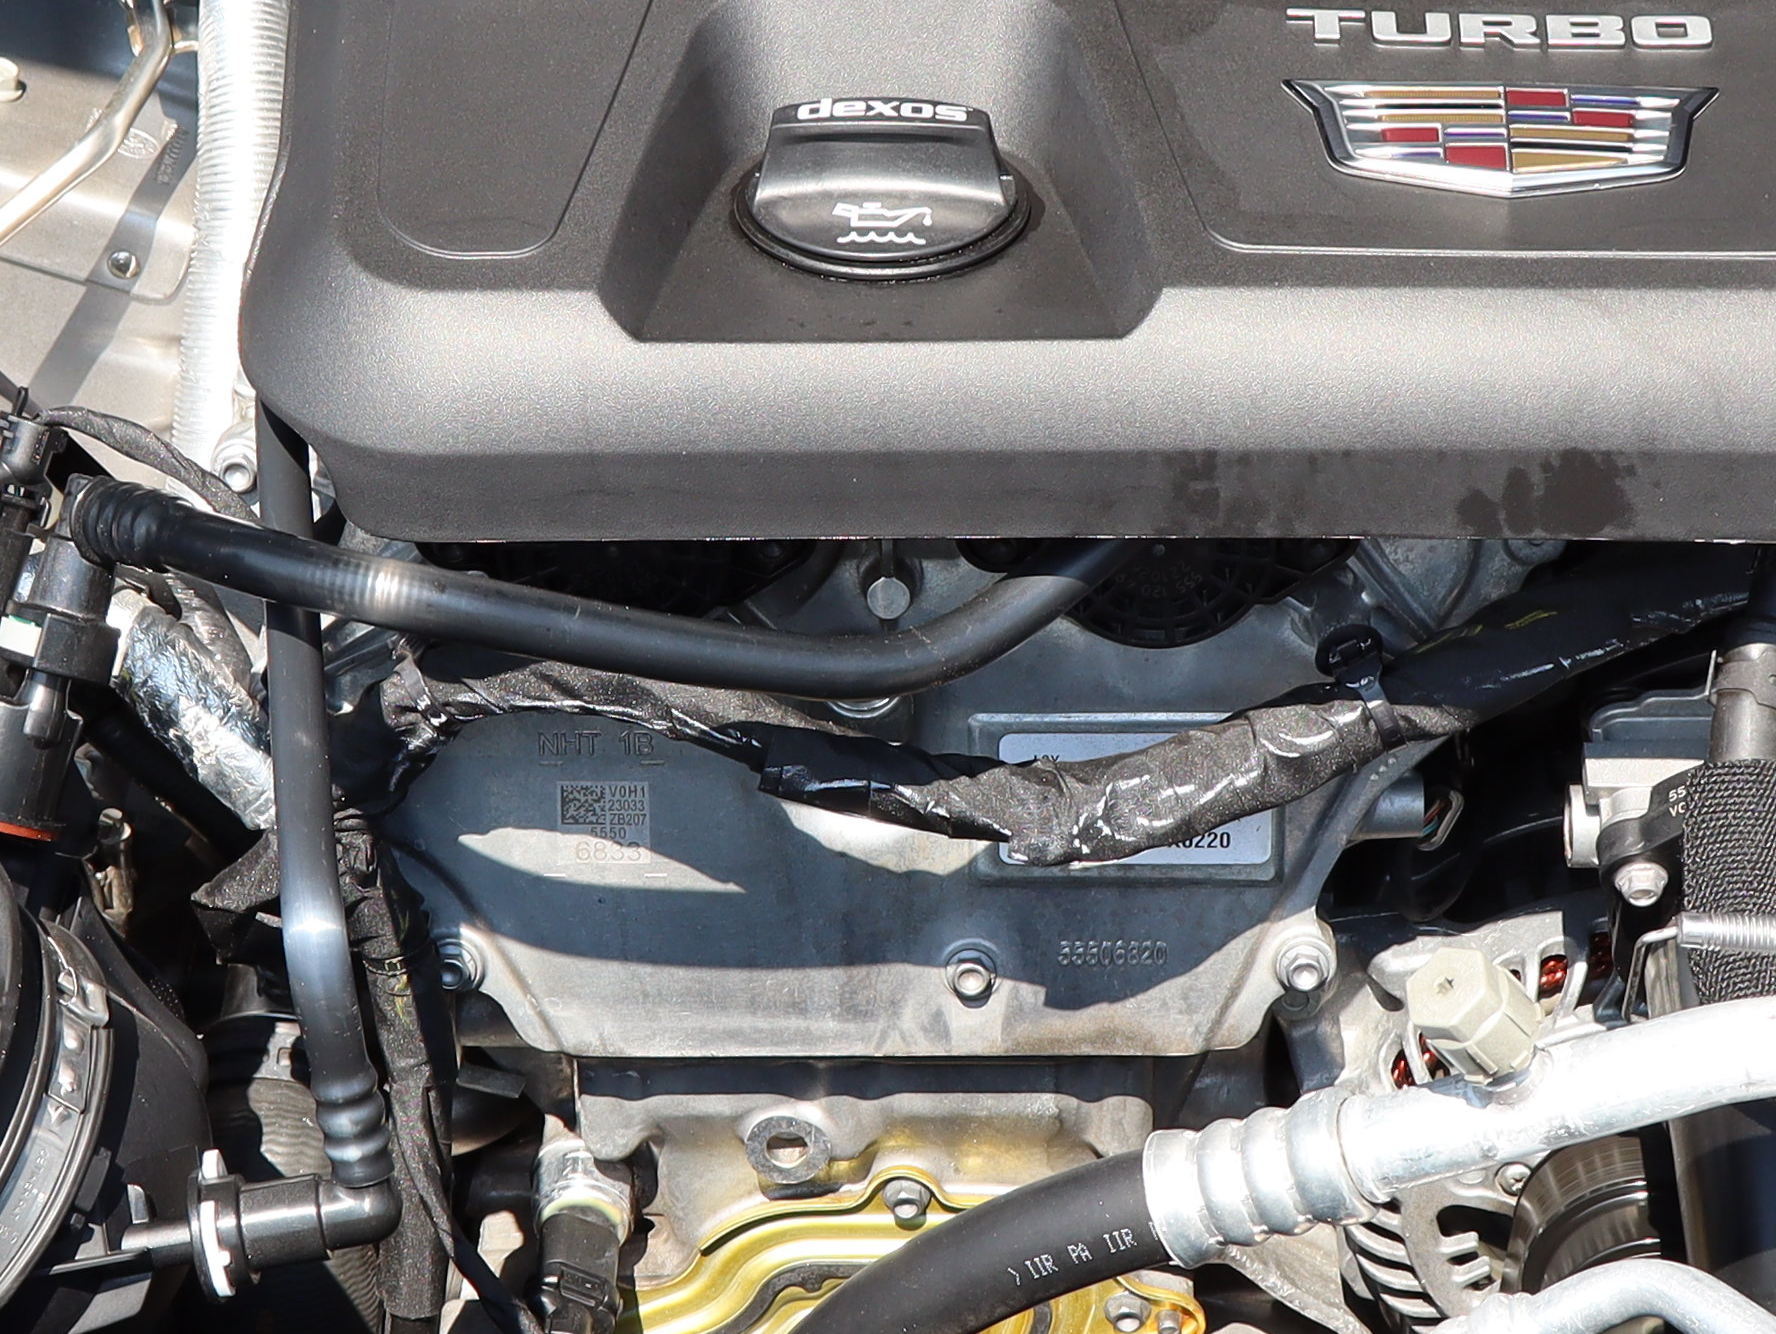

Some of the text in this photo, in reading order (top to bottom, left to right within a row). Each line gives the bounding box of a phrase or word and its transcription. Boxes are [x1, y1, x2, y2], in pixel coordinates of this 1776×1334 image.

[1286, 7, 1713, 52] TURBO
[797, 98, 969, 122] dexos
[537, 730, 655, 757] NHT 1B
[608, 799, 646, 812] 23033
[609, 813, 647, 826] ZB207
[590, 826, 627, 839] 5550
[576, 841, 642, 861] 6833
[1066, 1242, 1093, 1264] PA
